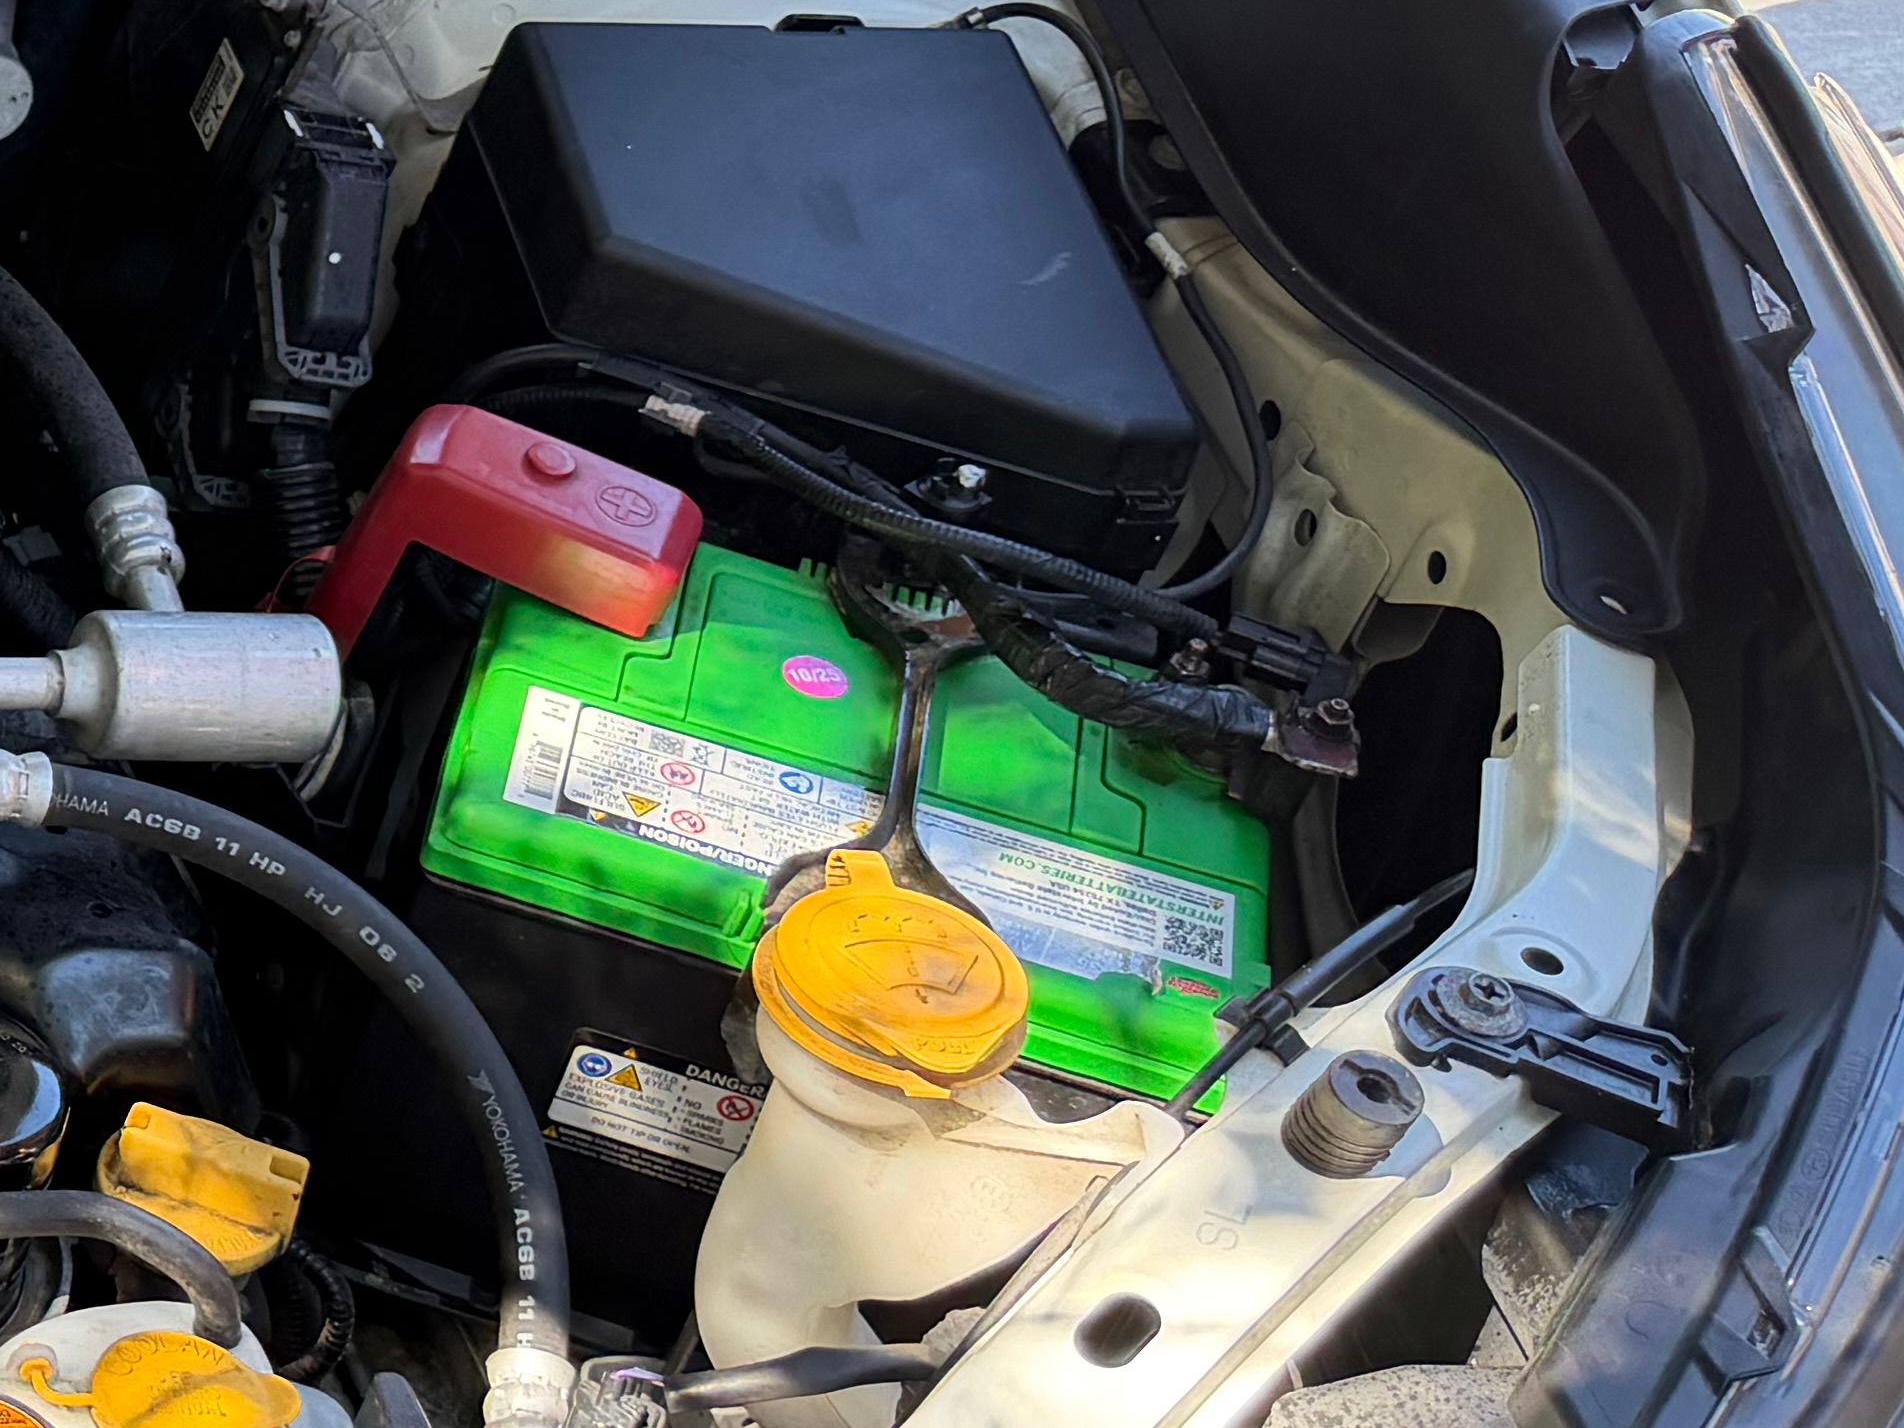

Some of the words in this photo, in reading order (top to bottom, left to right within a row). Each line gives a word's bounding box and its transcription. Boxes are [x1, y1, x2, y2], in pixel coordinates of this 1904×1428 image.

[788, 667, 841, 683] 10/25
[638, 823, 772, 876] NGER/POISON
[52, 793, 109, 817] HAMA
[214, 836, 241, 857] 11
[249, 851, 287, 877] HP
[304, 885, 342, 917] HJ
[404, 973, 425, 994] 2
[998, 851, 1224, 925] INTERSTATEBATTERIES.COM
[684, 1099, 701, 1110] NO
[685, 1064, 765, 1098] DANGER
[480, 1094, 527, 1194] YOKOHAMA
[513, 1207, 536, 1282] AC6B
[1195, 1203, 1253, 1251] SL
[517, 1295, 536, 1320] 11
[101, 1329, 242, 1376] COOLAN
